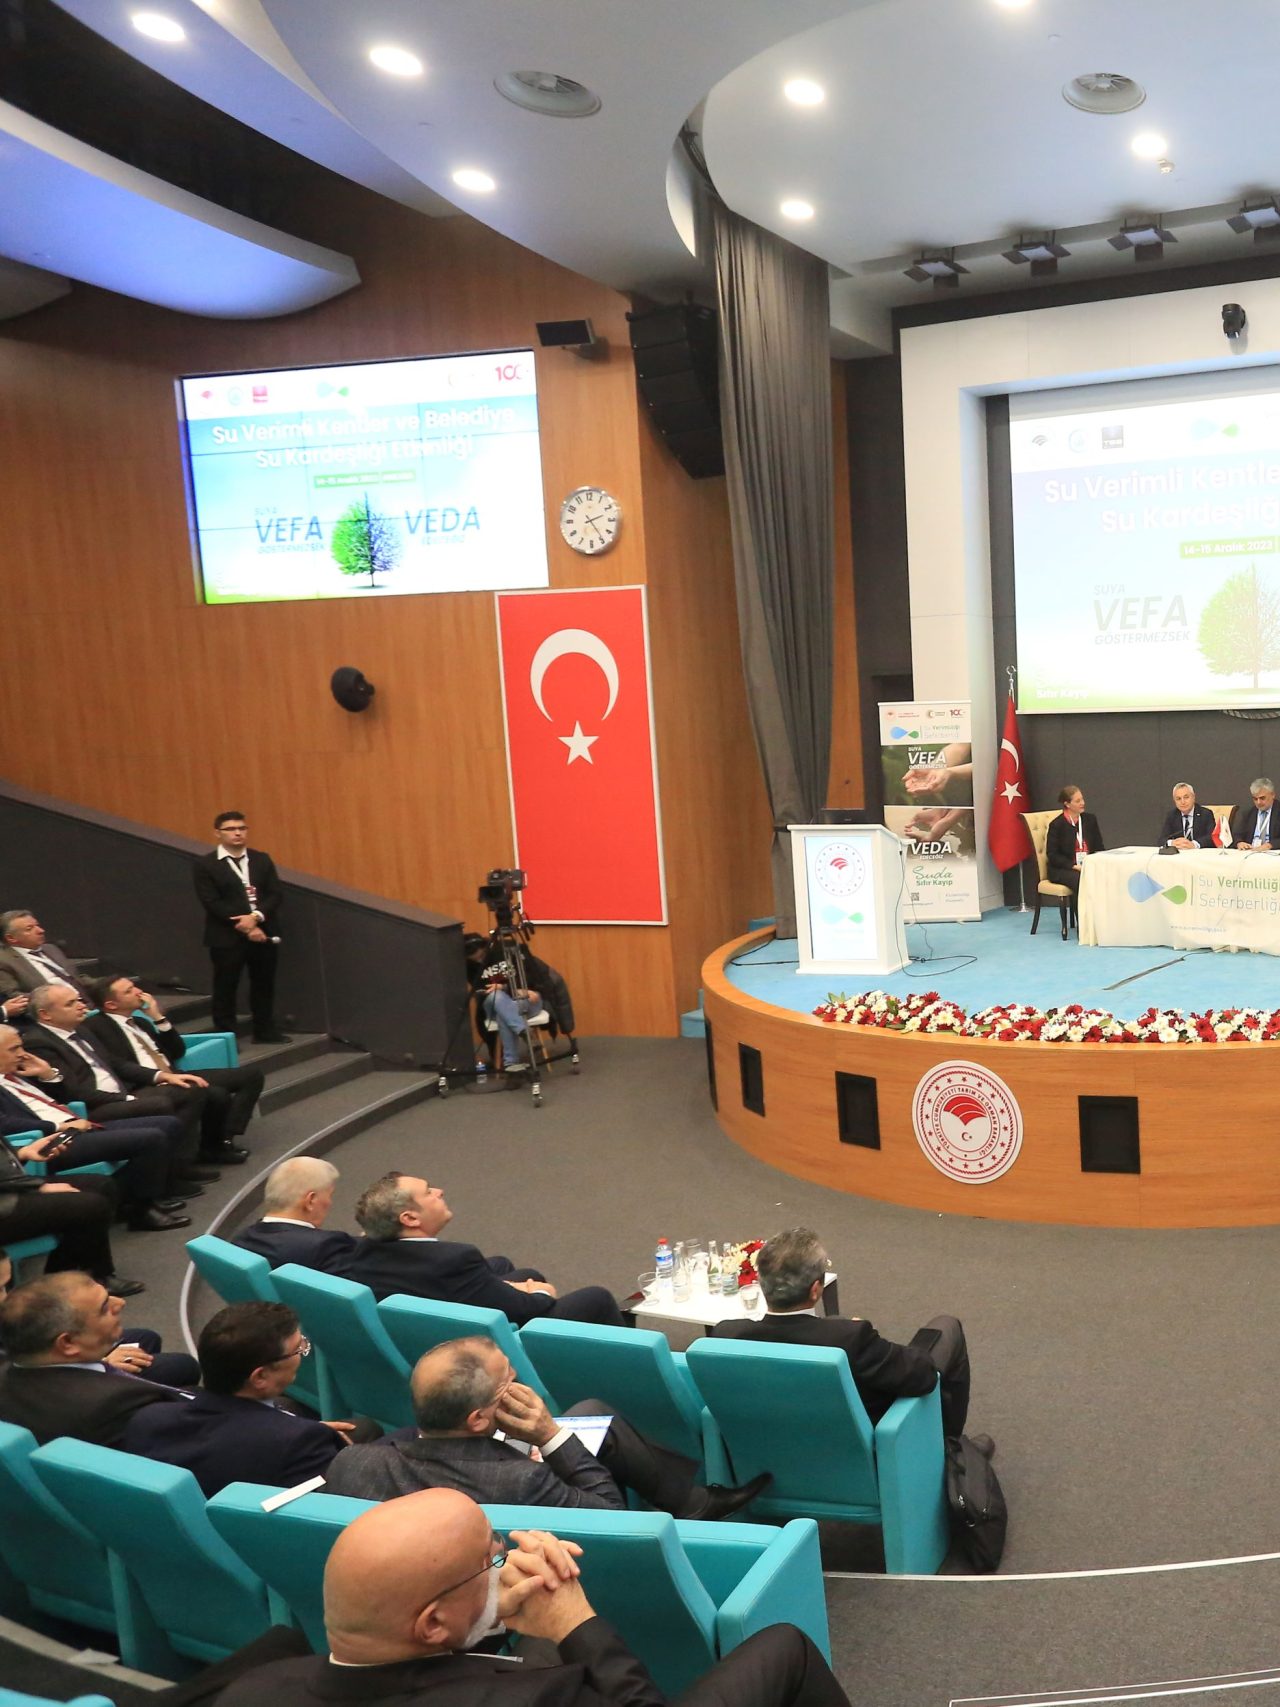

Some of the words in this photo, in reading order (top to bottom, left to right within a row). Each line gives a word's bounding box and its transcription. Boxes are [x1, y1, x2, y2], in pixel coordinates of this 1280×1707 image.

[212, 426, 238, 444] Su
[395, 416, 420, 430] ve
[425, 404, 516, 431] Belediye
[256, 450, 282, 469] Su
[1044, 479, 1078, 503] Su
[1084, 467, 1184, 499] Verimli
[404, 505, 481, 535] VEDA
[1102, 509, 1137, 533] Su
[255, 516, 323, 543] VEFA
[1247, 539, 1273, 551] 2023
[1093, 583, 1127, 596] SUYA
[1093, 593, 1188, 631] VEFA
[1094, 630, 1191, 646] GÖSTERMEZSEK
[908, 751, 946, 764] VEFA
[911, 841, 952, 855] VEDA
[912, 866, 953, 880] Suda
[1198, 875, 1213, 888] Su
